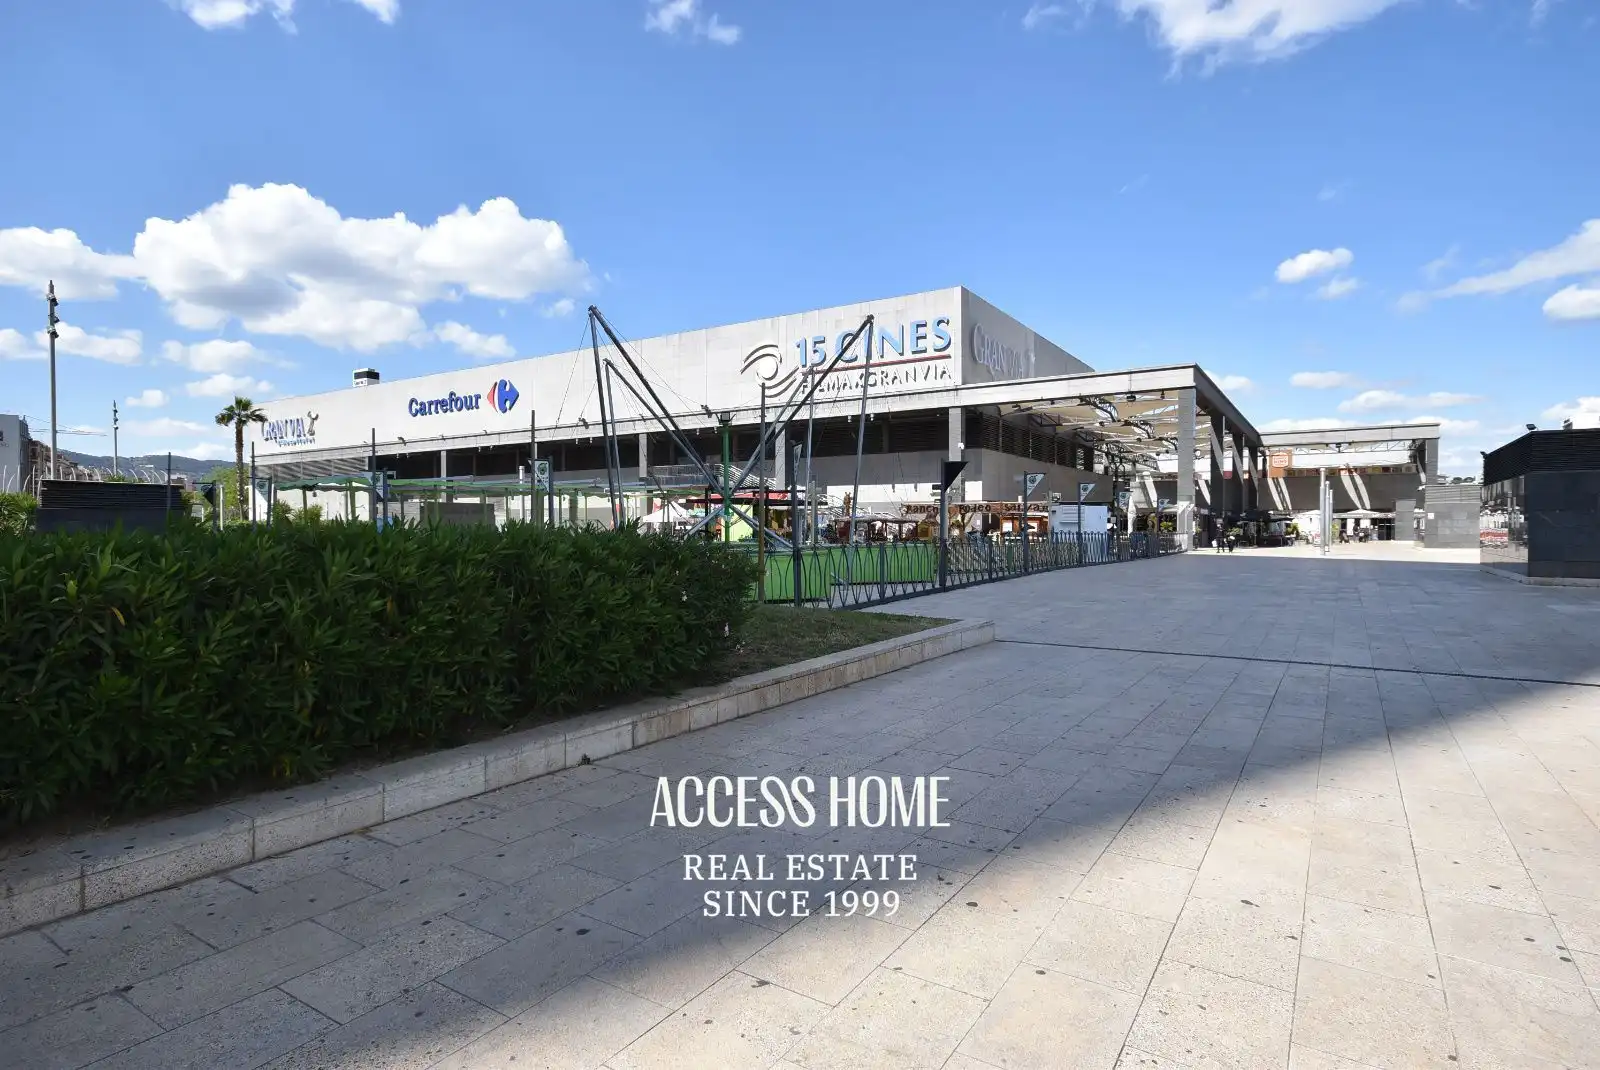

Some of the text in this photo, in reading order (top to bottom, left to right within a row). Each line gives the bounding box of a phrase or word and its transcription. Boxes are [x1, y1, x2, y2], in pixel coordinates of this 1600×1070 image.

[794, 315, 952, 368] 15 CINES
[408, 390, 482, 418] Carrefour
